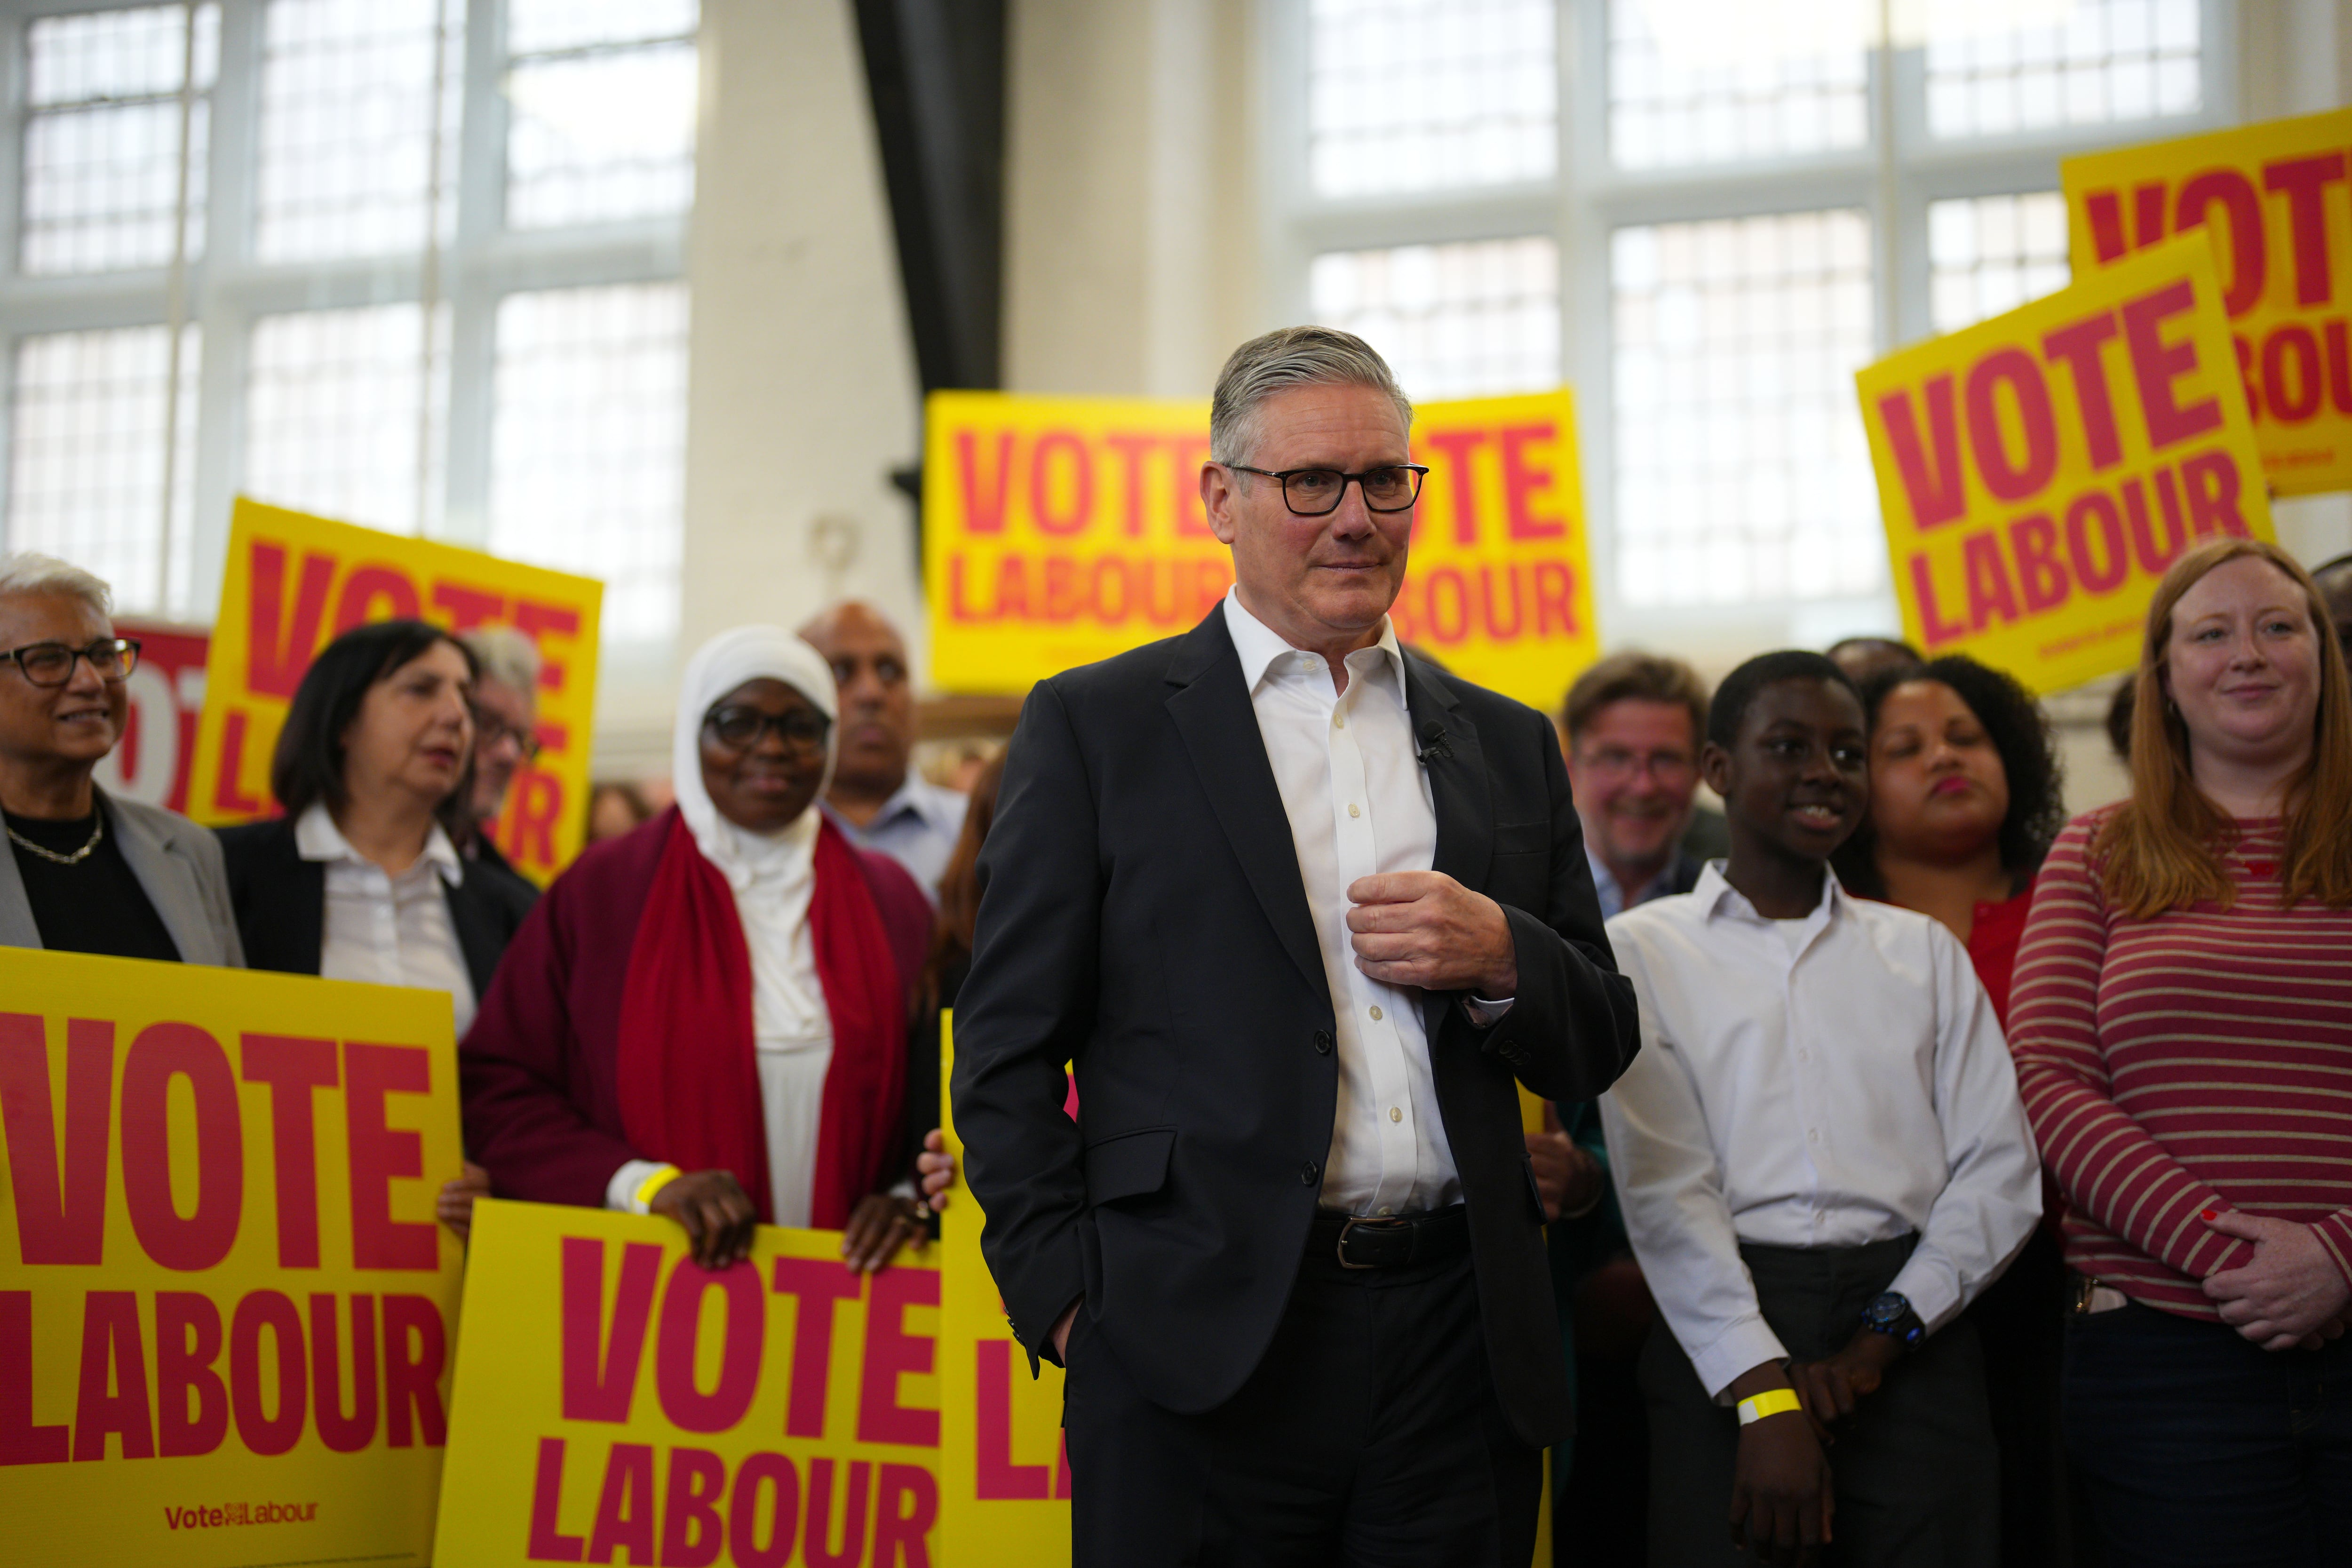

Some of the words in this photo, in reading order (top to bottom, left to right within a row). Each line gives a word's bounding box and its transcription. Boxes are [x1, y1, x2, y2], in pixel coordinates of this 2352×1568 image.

[2085, 150, 2352, 320] VOT
[1409, 423, 1565, 546] TE
[1877, 275, 2226, 533] VOTE
[1907, 449, 2254, 651] LABOUR
[0, 1011, 440, 1272] VOTE
[0, 1288, 450, 1467] LABOUR
[560, 1236, 941, 1448] VOTE
[165, 1504, 223, 1530] Vote
[244, 1501, 318, 1525] Labour
[526, 1436, 941, 1568] LABOUR
